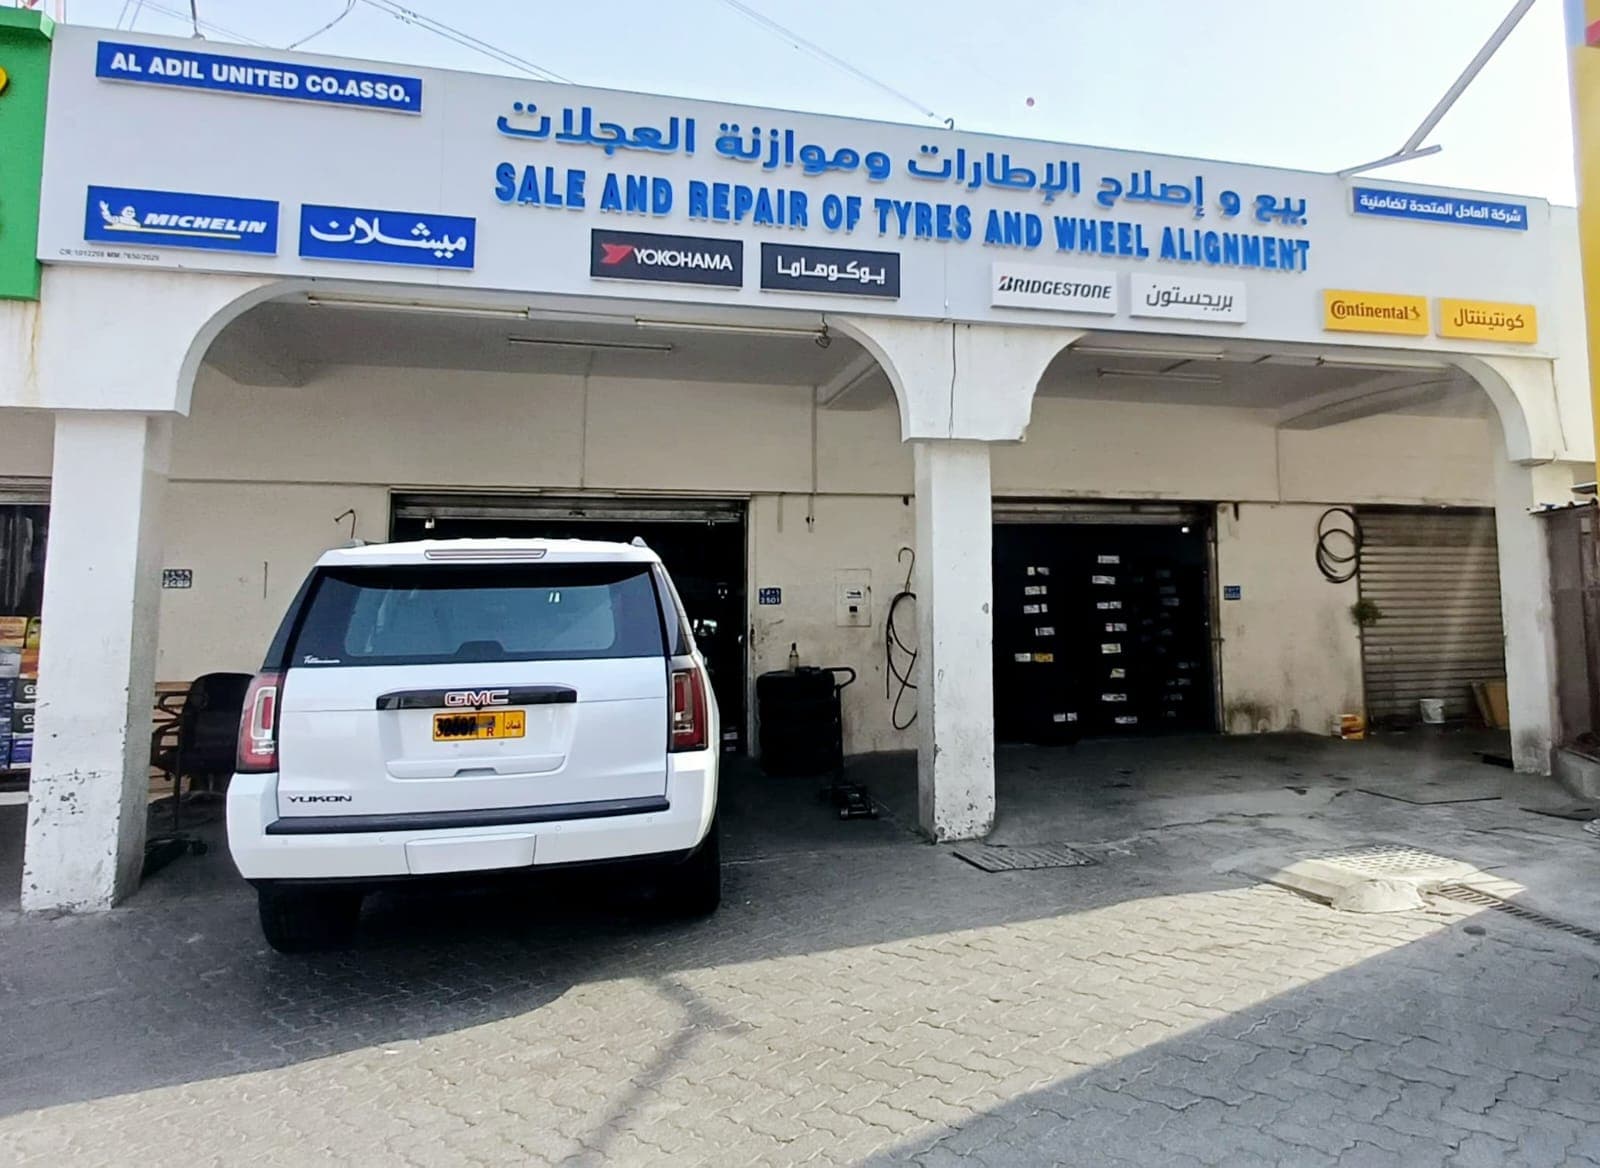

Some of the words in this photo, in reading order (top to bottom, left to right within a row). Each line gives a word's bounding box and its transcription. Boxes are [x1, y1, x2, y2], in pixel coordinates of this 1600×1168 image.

[111, 52, 142, 73] AL
[149, 57, 204, 79] ADIL
[212, 64, 299, 90] UNITED
[305, 76, 411, 103] CO.ASSO.
[496, 102, 696, 158] العجلات
[715, 122, 892, 182] وموازنة
[907, 145, 1082, 205] الإطارات
[1096, 170, 1205, 218] إصلاح
[1220, 190, 1242, 217] و
[1360, 194, 1407, 210] تضامنية
[495, 162, 587, 210] SALE
[600, 172, 674, 217] AND
[688, 179, 809, 229] REPAIR
[822, 194, 863, 233] OF
[874, 198, 973, 243] TYRES
[984, 208, 1044, 250] AND
[1054, 216, 1150, 259] WHEEL
[1160, 226, 1311, 273] ALIGNMENT
[1255, 193, 1308, 225] بيع
[1409, 200, 1453, 215] المتحدة
[1455, 204, 1489, 219] العادل
[1491, 208, 1522, 224] شركة
[144, 212, 267, 234] MICHELIN
[309, 216, 467, 259] ميشلان
[633, 247, 733, 271] YOKOHAMA
[776, 255, 886, 284] يوكوهاما
[998, 275, 1113, 300] BRIDGESTONE
[1146, 284, 1234, 312] بريجستون
[1330, 299, 1409, 320] Continental
[1454, 308, 1525, 331] كونتيننتال
[445, 689, 510, 706] GMC
[486, 727, 494, 737] R
[287, 795, 353, 803] YUKON
